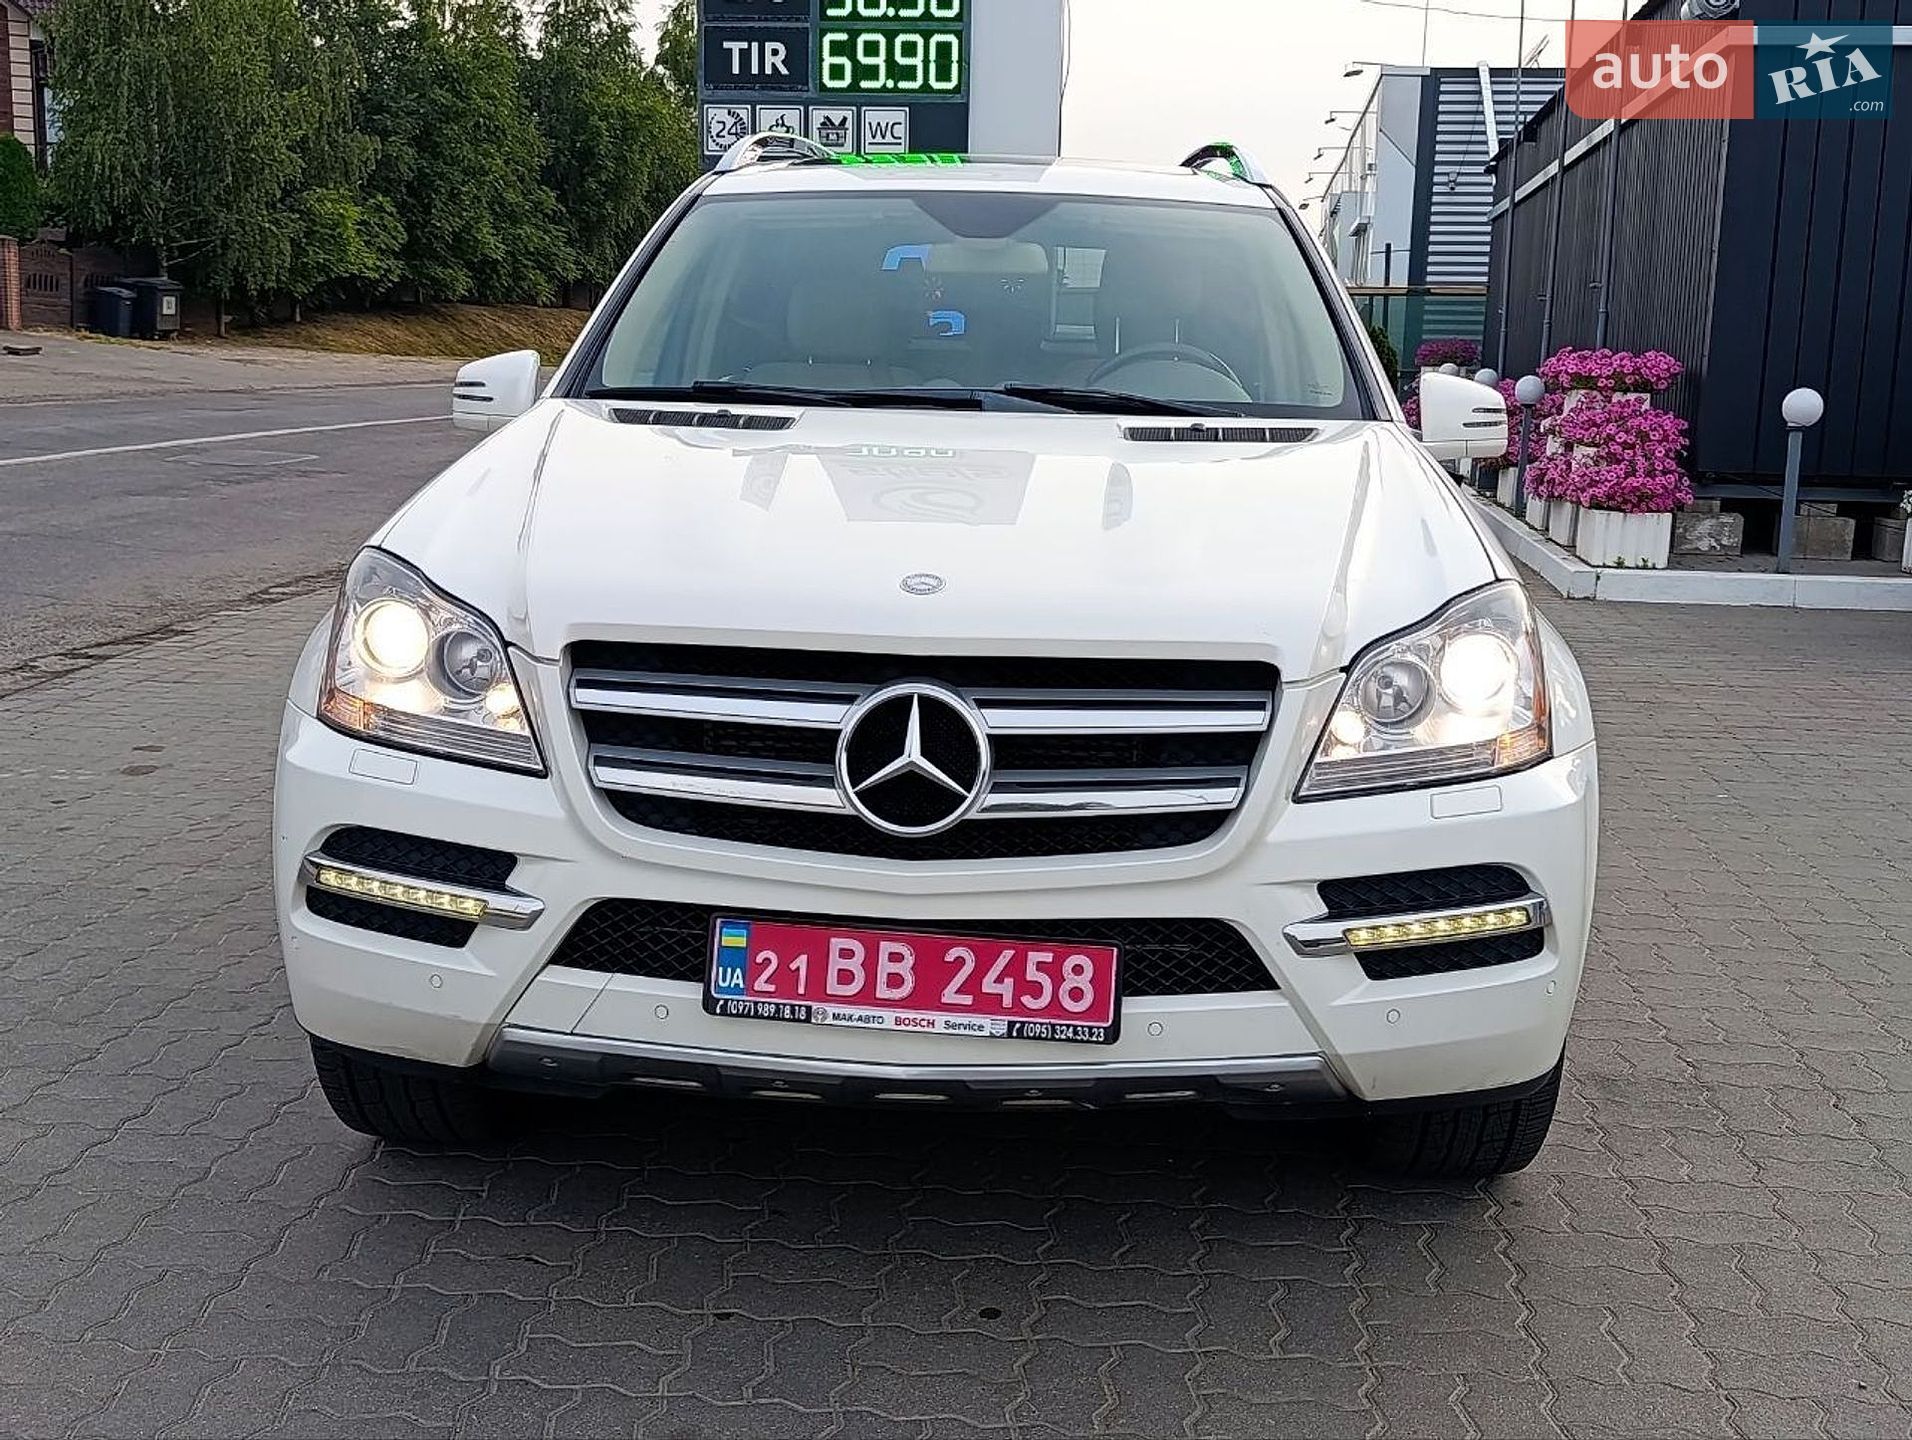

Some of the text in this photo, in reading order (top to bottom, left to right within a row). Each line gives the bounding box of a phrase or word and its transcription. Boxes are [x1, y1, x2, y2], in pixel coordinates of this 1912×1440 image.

[722, 32, 959, 90] TIR 69.90
[715, 120, 740, 140] 24
[868, 121, 902, 140] WC
[718, 966, 745, 989] UA
[753, 937, 1096, 1014] 21 BB 2458
[894, 1015, 936, 1029] BOSCH
[943, 1019, 986, 1032] Service
[1023, 1023, 1052, 1039] (095)
